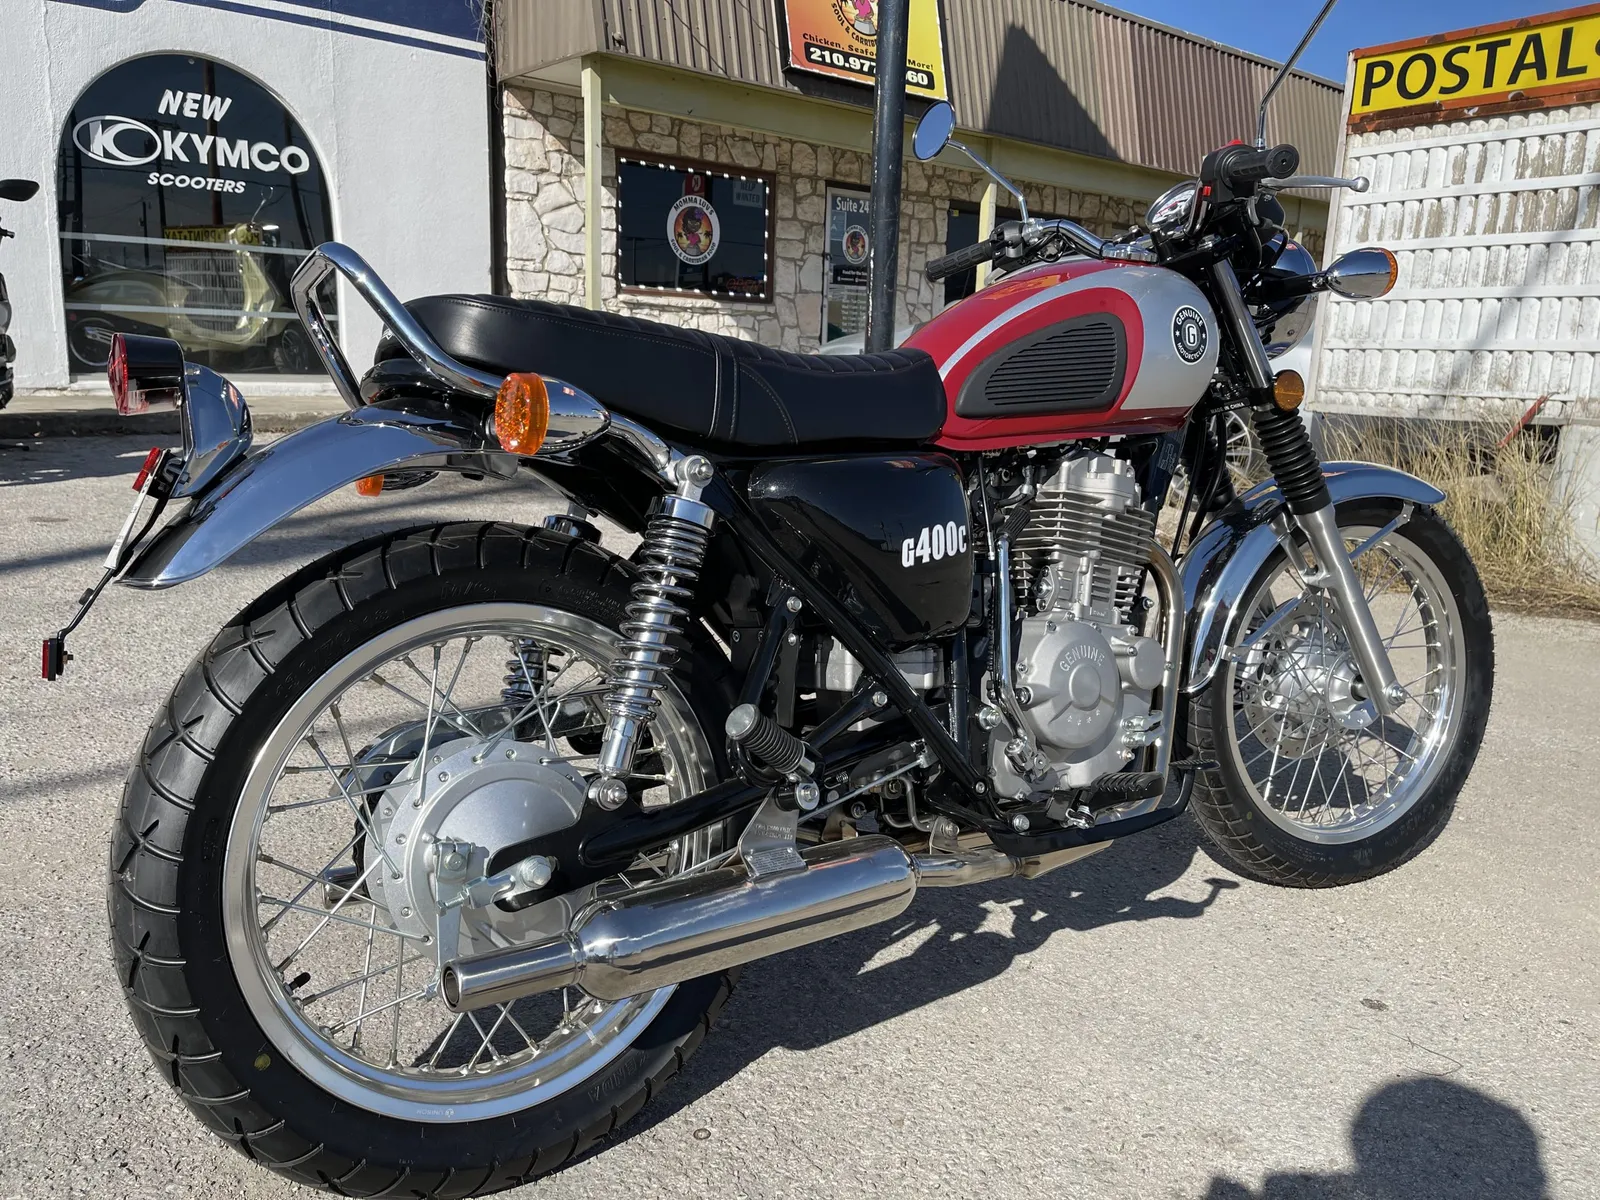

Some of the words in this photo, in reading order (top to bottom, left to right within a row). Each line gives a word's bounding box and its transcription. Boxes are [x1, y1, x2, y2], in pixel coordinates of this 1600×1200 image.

[831, 2, 845, 27] SOUL
[845, 26, 851, 34] &
[851, 32, 877, 48] CARRIB
[848, 44, 877, 58] Seafo
[907, 59, 934, 71] More!
[1361, 26, 1588, 107] POSTAL
[157, 88, 232, 122] NEW
[162, 130, 310, 175] KYMCO
[147, 171, 247, 195] SCOOTERS
[673, 196, 698, 212] MOMMA
[736, 192, 760, 204] WANTED
[836, 197, 857, 213] Suite
[859, 200, 869, 213] 24
[1175, 309, 1204, 327] GENUINE
[1185, 323, 1198, 347] G
[1177, 342, 1205, 360] MOTORCYCLES
[1059, 644, 1105, 672] GENUINE
